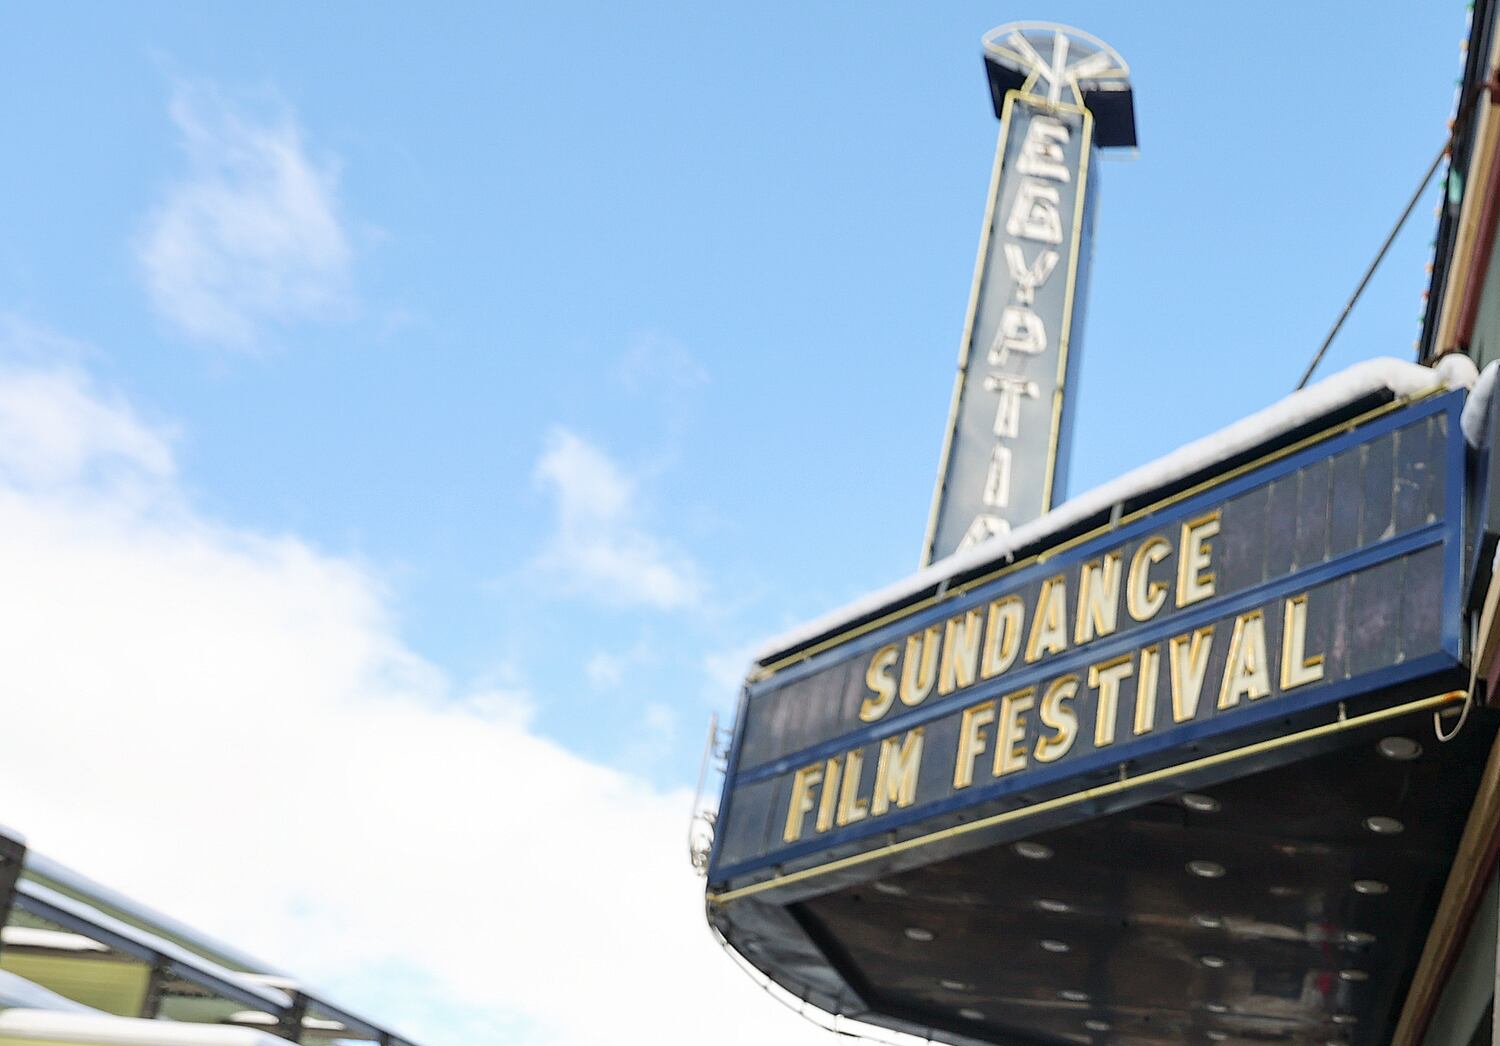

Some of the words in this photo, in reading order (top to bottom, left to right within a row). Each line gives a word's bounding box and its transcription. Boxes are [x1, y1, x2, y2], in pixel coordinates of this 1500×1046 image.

[782, 726, 924, 844] FILM
[953, 592, 1324, 790] FESTIVAL
[859, 508, 1221, 723] SUNDANCE
